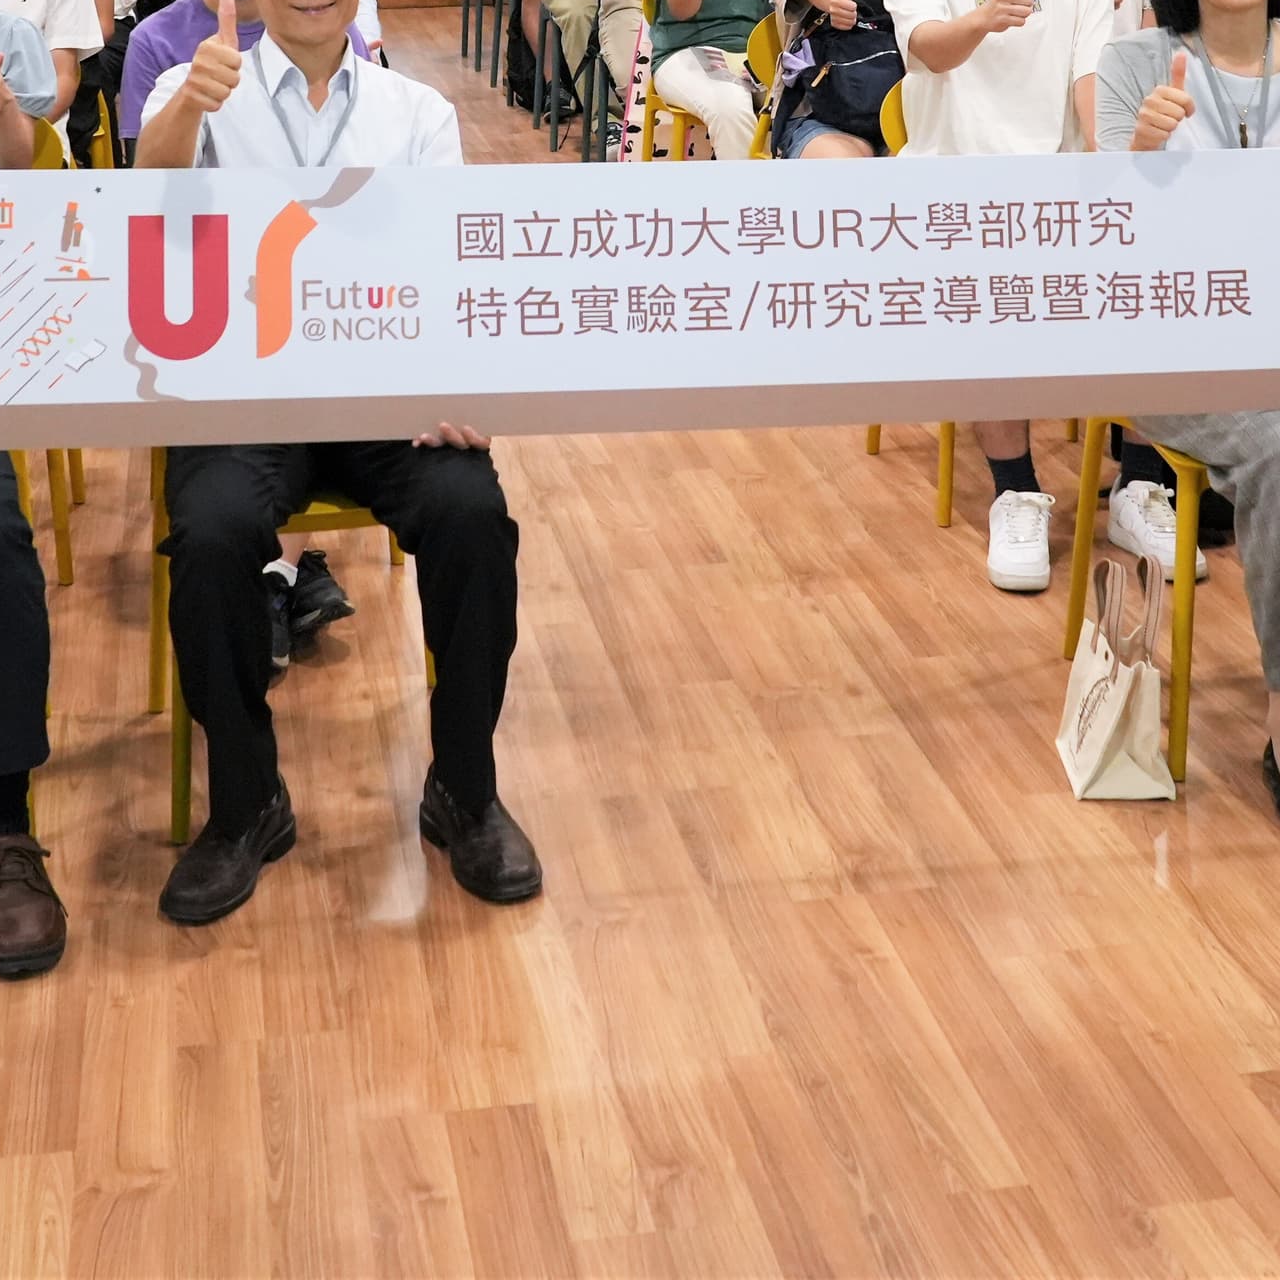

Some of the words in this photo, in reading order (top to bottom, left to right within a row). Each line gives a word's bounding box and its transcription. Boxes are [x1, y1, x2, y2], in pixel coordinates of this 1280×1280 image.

[456, 197, 1135, 262] 國立成功大學UR大學部研究
[301, 280, 420, 311] Future
[456, 268, 1252, 338] 特色實驗室/研究室導覽暨海報展
[302, 316, 421, 341] @NCKU
